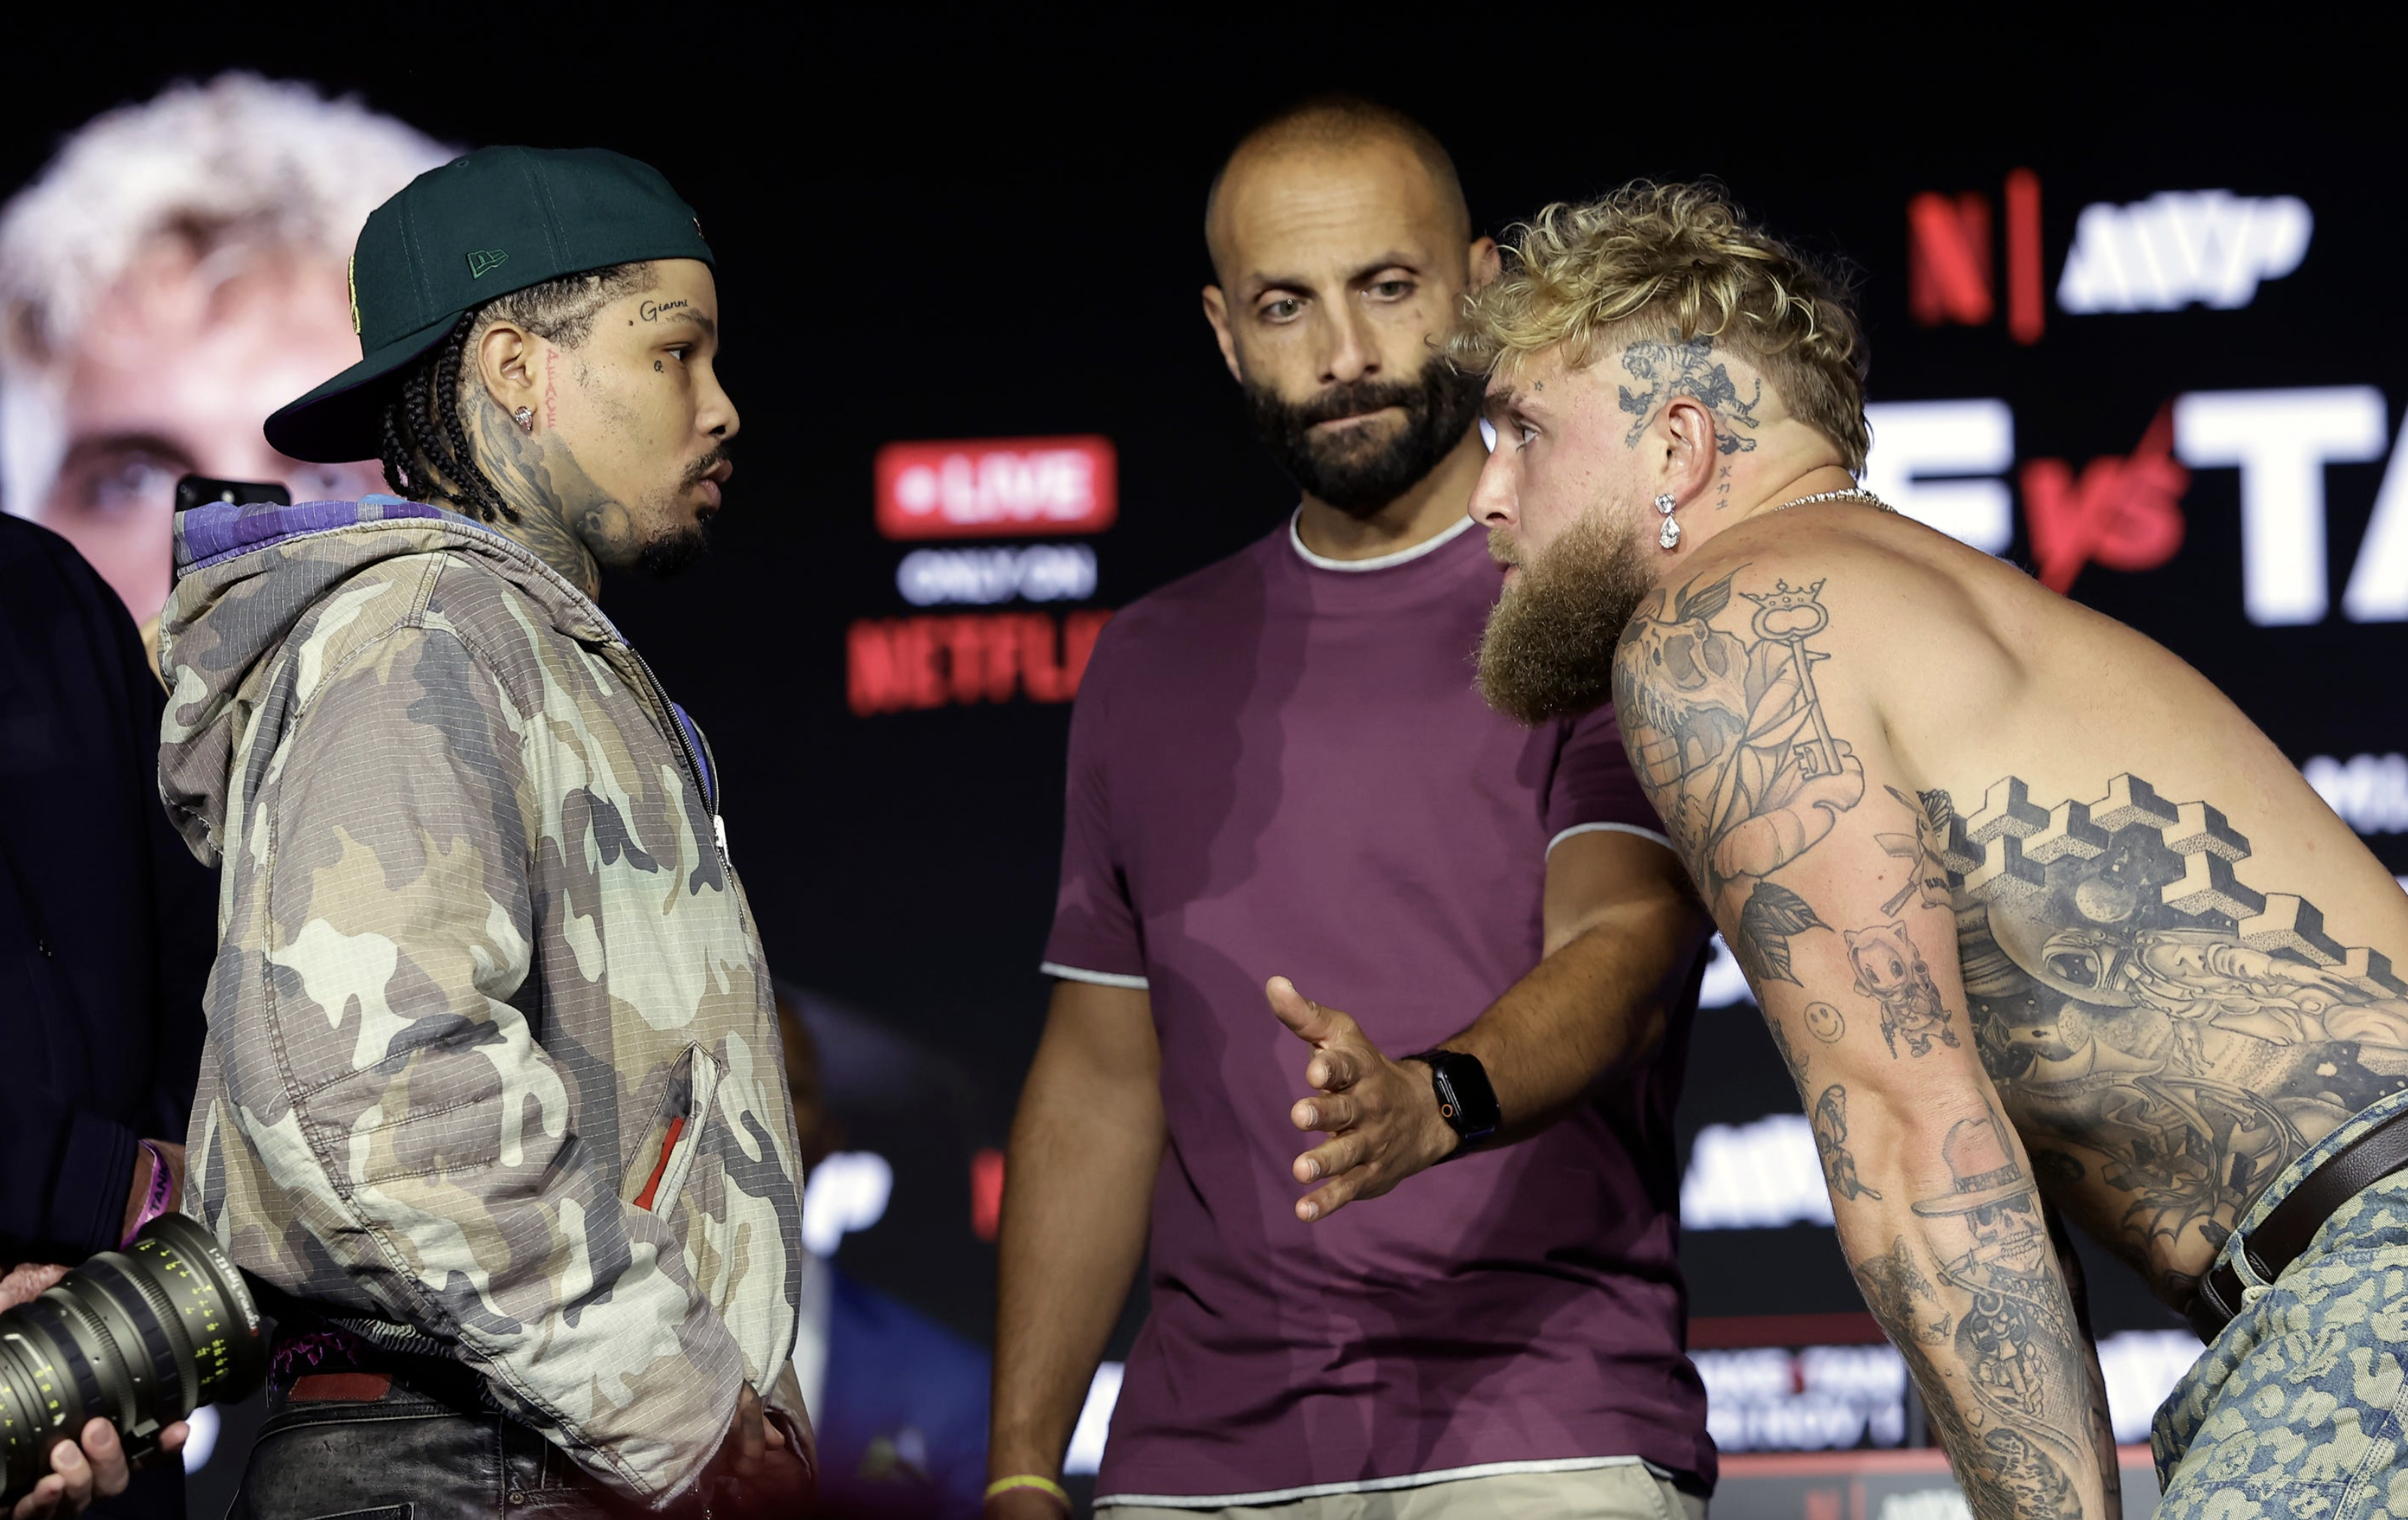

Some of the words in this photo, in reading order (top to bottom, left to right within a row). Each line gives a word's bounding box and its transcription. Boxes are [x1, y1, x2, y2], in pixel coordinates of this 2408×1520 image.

[640, 299, 688, 322] Gianni
[940, 451, 1096, 524] LIVE
[895, 548, 1019, 606] ONLY
[846, 610, 1114, 719] NETFLI
